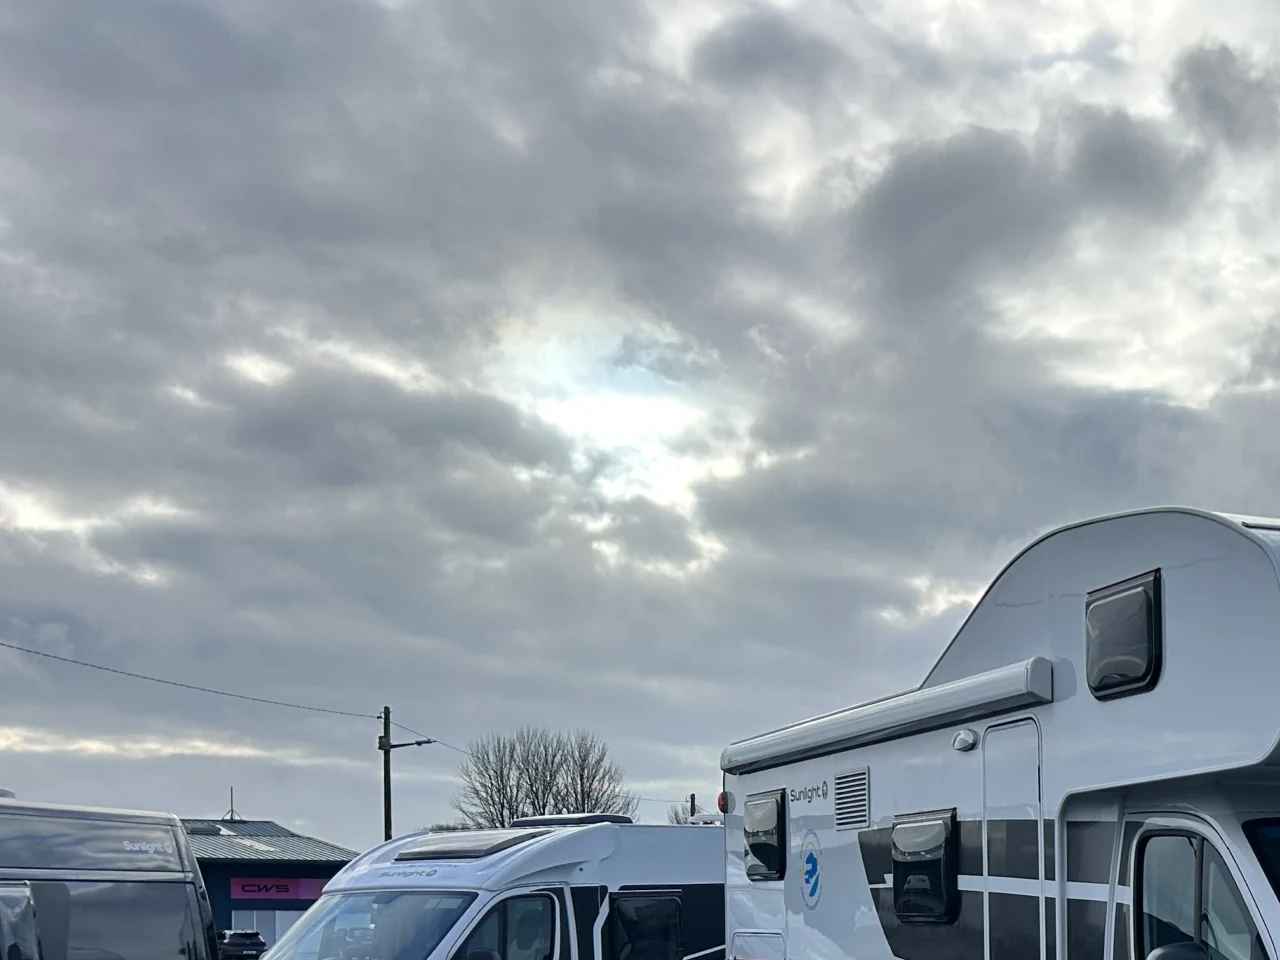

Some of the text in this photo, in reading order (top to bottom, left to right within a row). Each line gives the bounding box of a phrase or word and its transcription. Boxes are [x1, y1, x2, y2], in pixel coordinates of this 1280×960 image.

[790, 785, 821, 803] Sunlight
[122, 840, 165, 854] Sunlight
[241, 884, 290, 893] CWS
